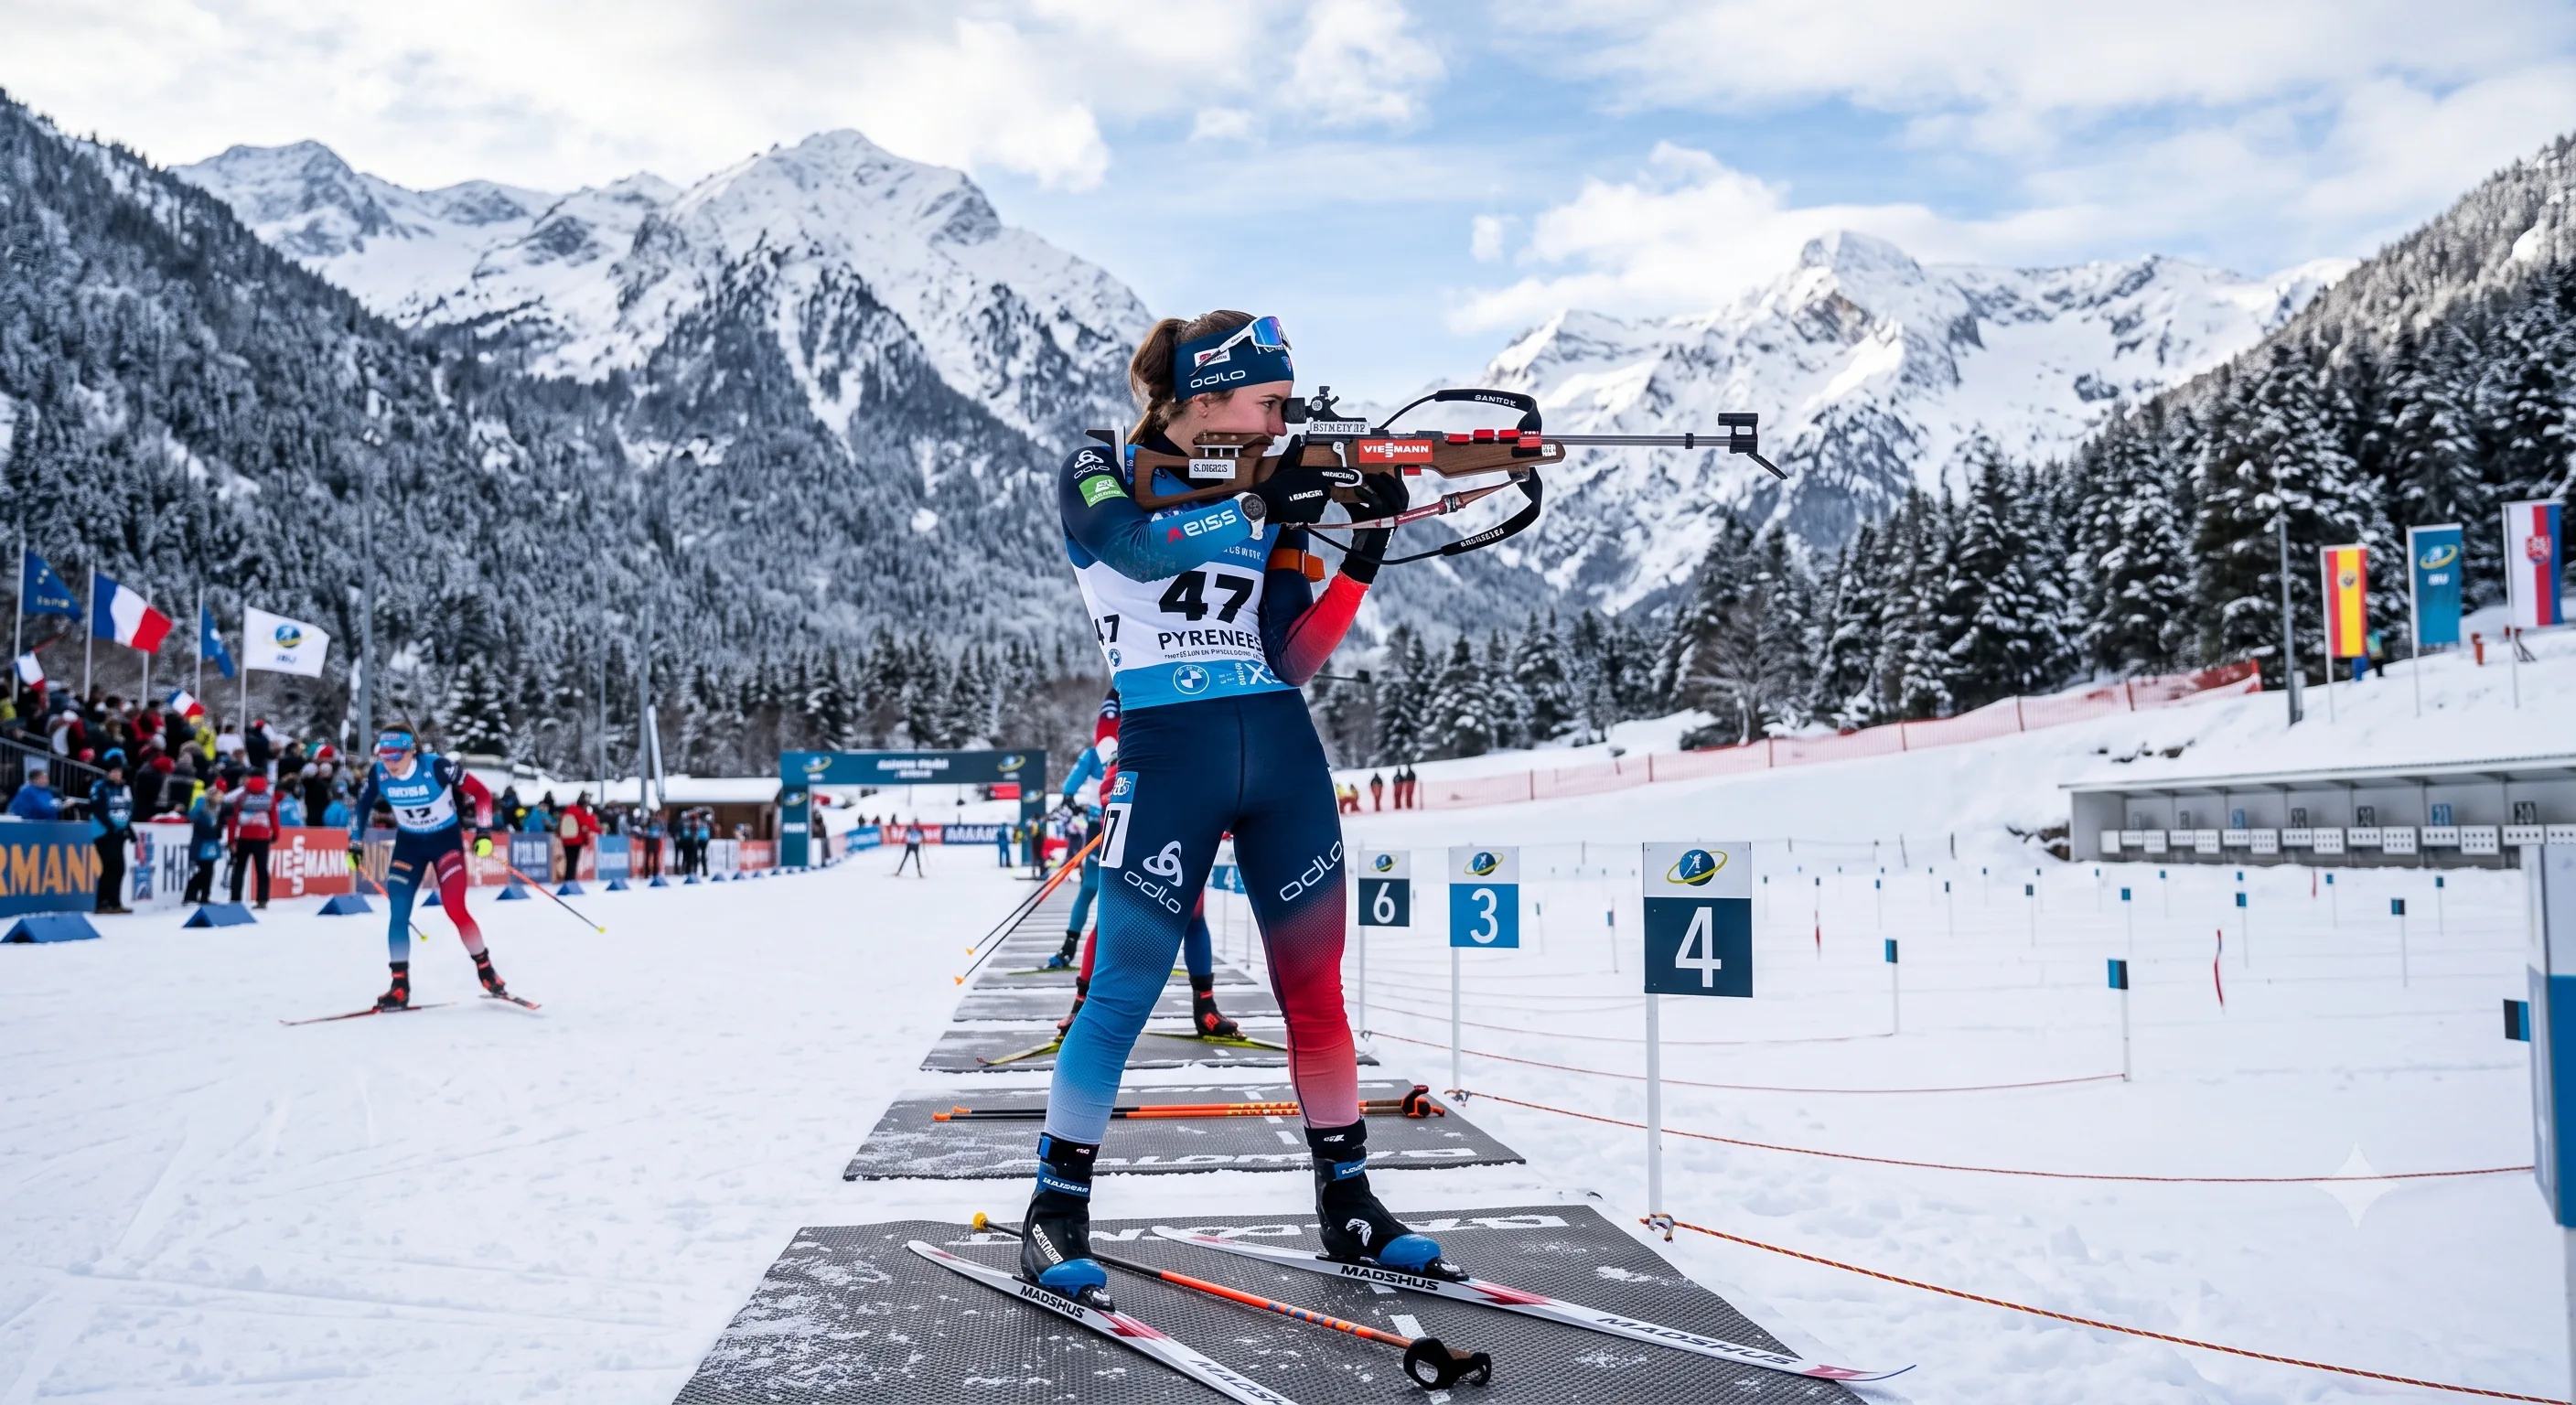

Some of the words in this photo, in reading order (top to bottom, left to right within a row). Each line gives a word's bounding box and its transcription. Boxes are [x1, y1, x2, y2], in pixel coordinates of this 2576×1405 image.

[1190, 370, 1246, 389] odlo
[1158, 569, 1255, 625] 47
[1157, 628, 1263, 652] PYRENEES
[1123, 870, 1182, 914] odlo
[1278, 840, 1343, 902] odlo
[1372, 882, 1396, 924] 6
[1469, 887, 1498, 943] 3
[1675, 906, 1722, 988] 4
[1338, 1264, 1441, 1292] MADSHUS
[1019, 1284, 1086, 1319] MADSHUS
[1595, 1317, 1798, 1365] MADSHUS
